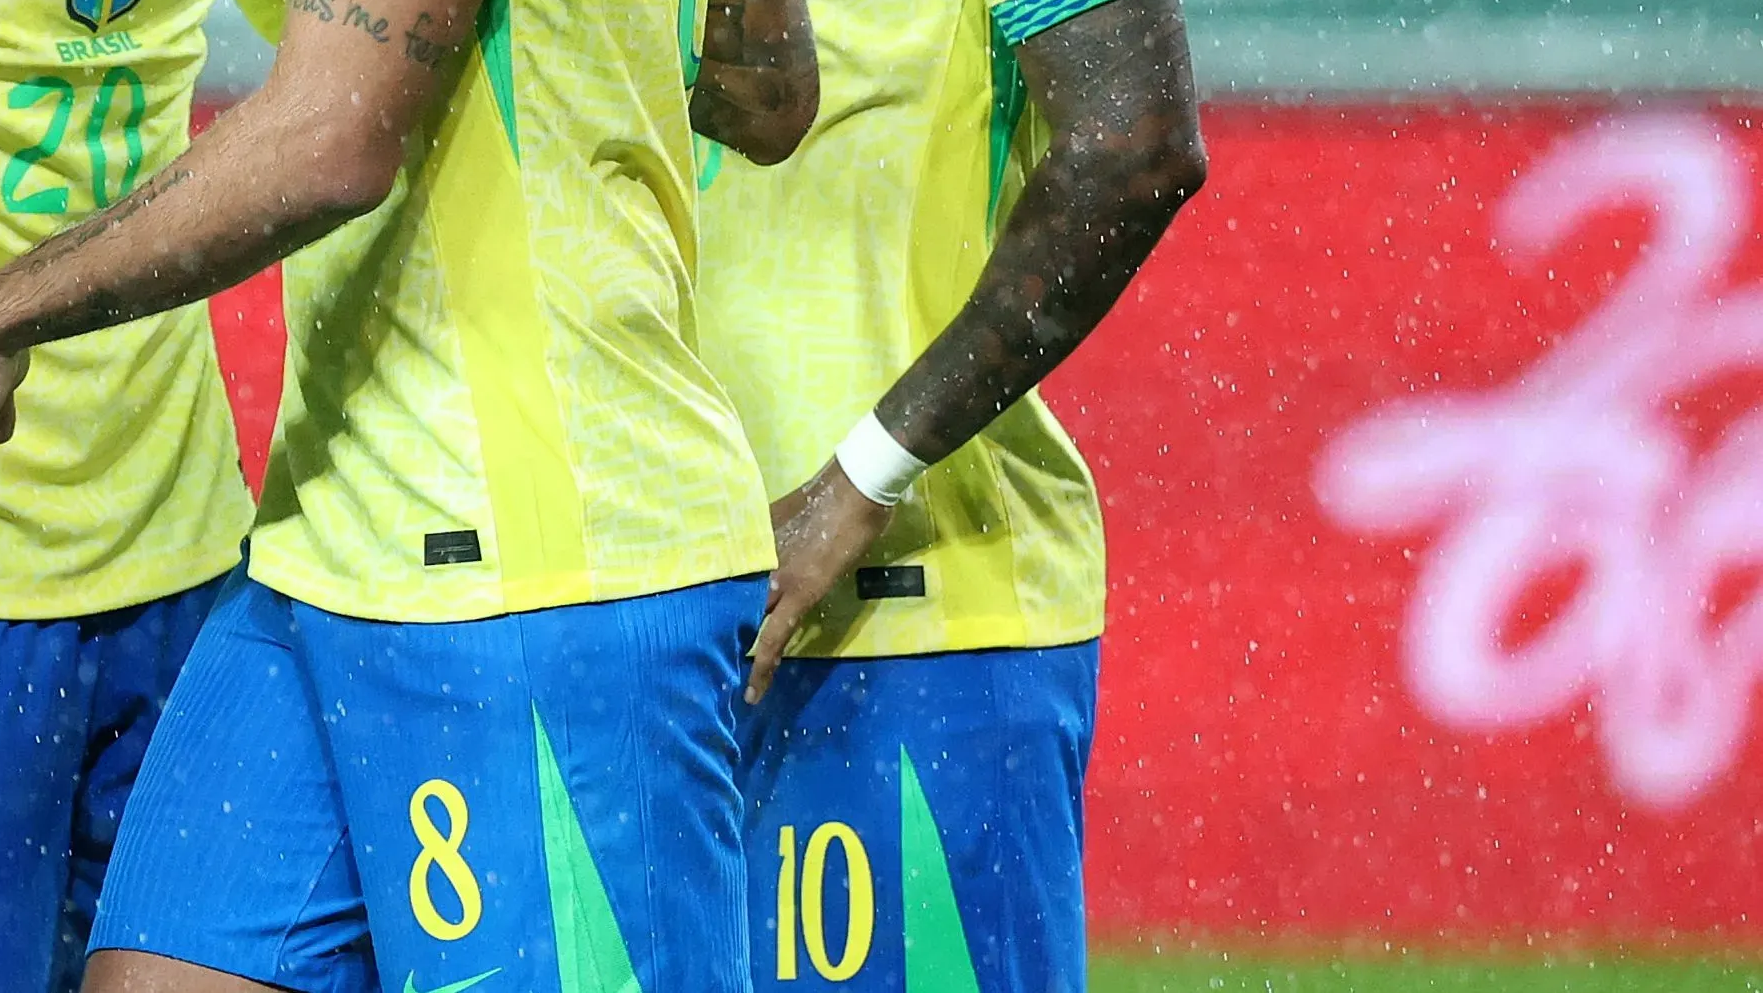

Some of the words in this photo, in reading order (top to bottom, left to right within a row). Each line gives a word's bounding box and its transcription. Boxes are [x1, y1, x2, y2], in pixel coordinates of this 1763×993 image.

[55, 30, 143, 63] BRASIL
[342, 1, 389, 43] me
[0, 65, 146, 214] 20
[408, 779, 483, 941] 8
[775, 821, 875, 983] 10
